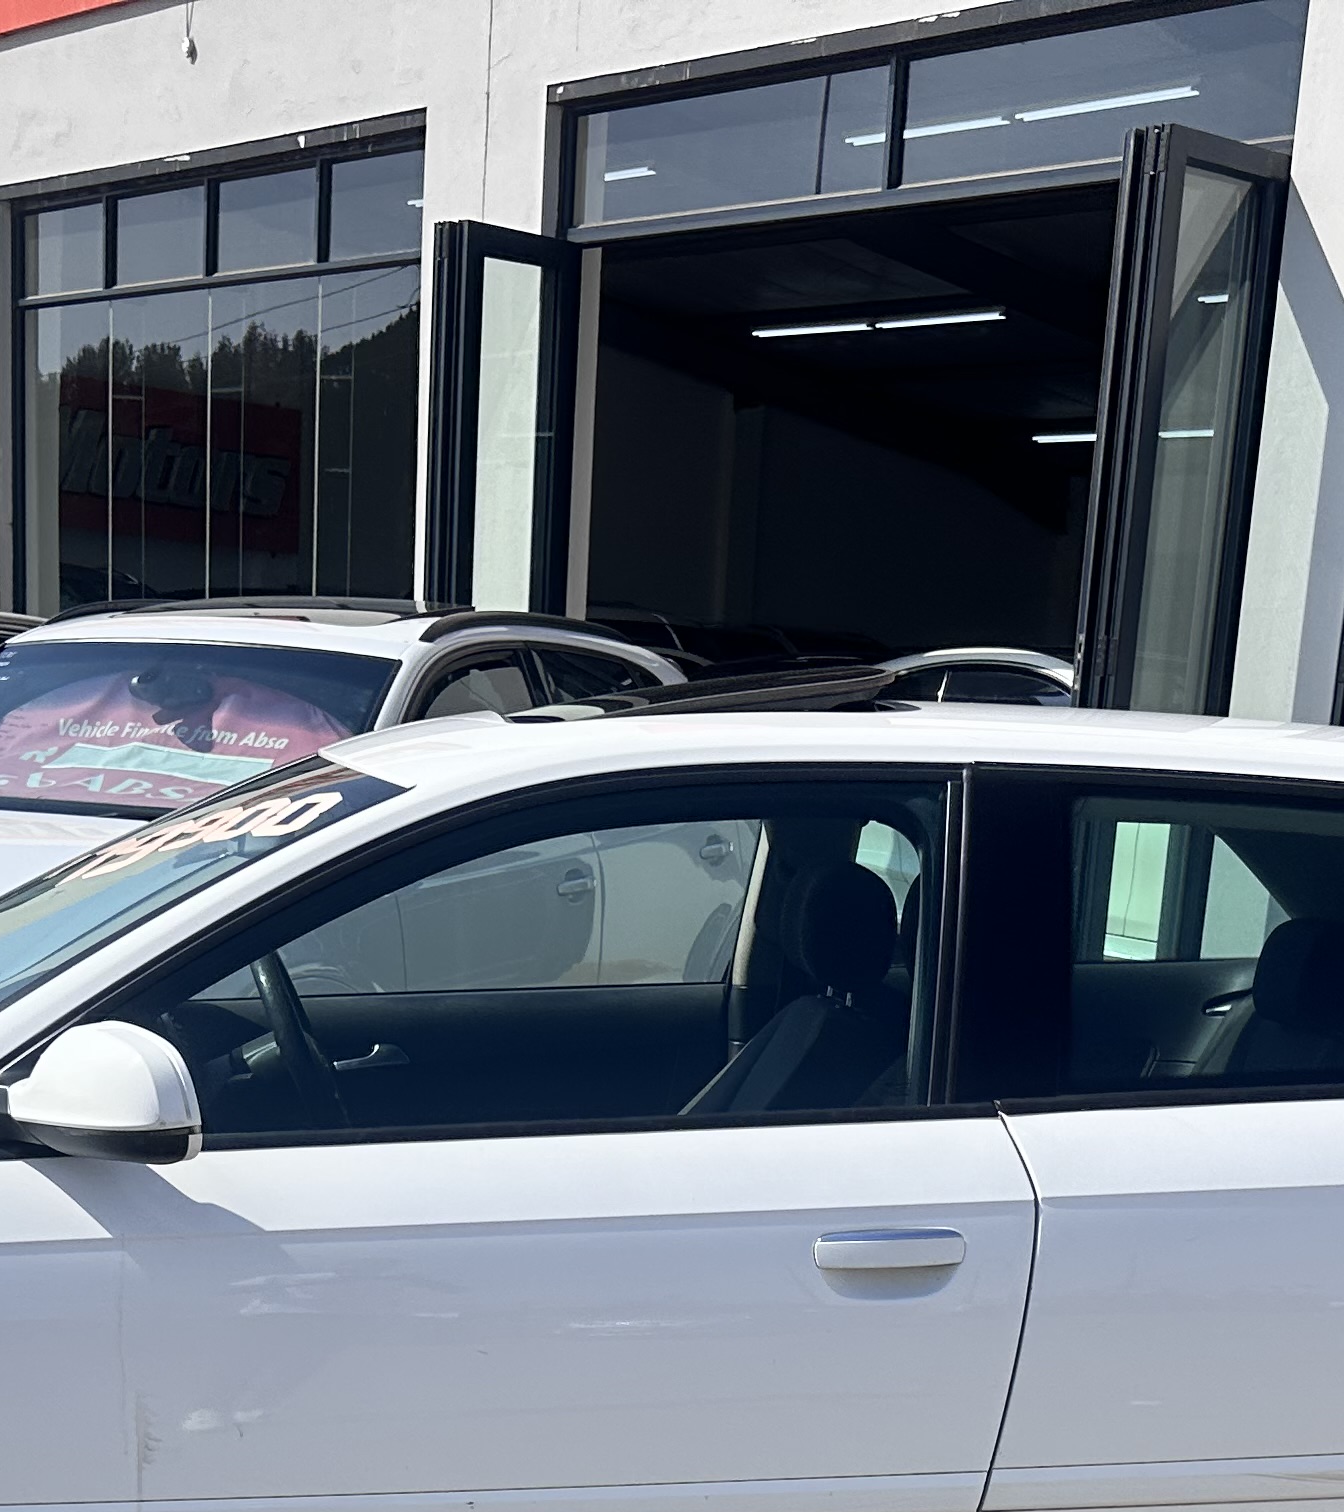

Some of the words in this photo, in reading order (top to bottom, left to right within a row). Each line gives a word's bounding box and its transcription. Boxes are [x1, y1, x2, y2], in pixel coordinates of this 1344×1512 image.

[59, 718, 119, 738] Vehicle
[186, 725, 236, 745] from
[239, 731, 289, 750] Absa
